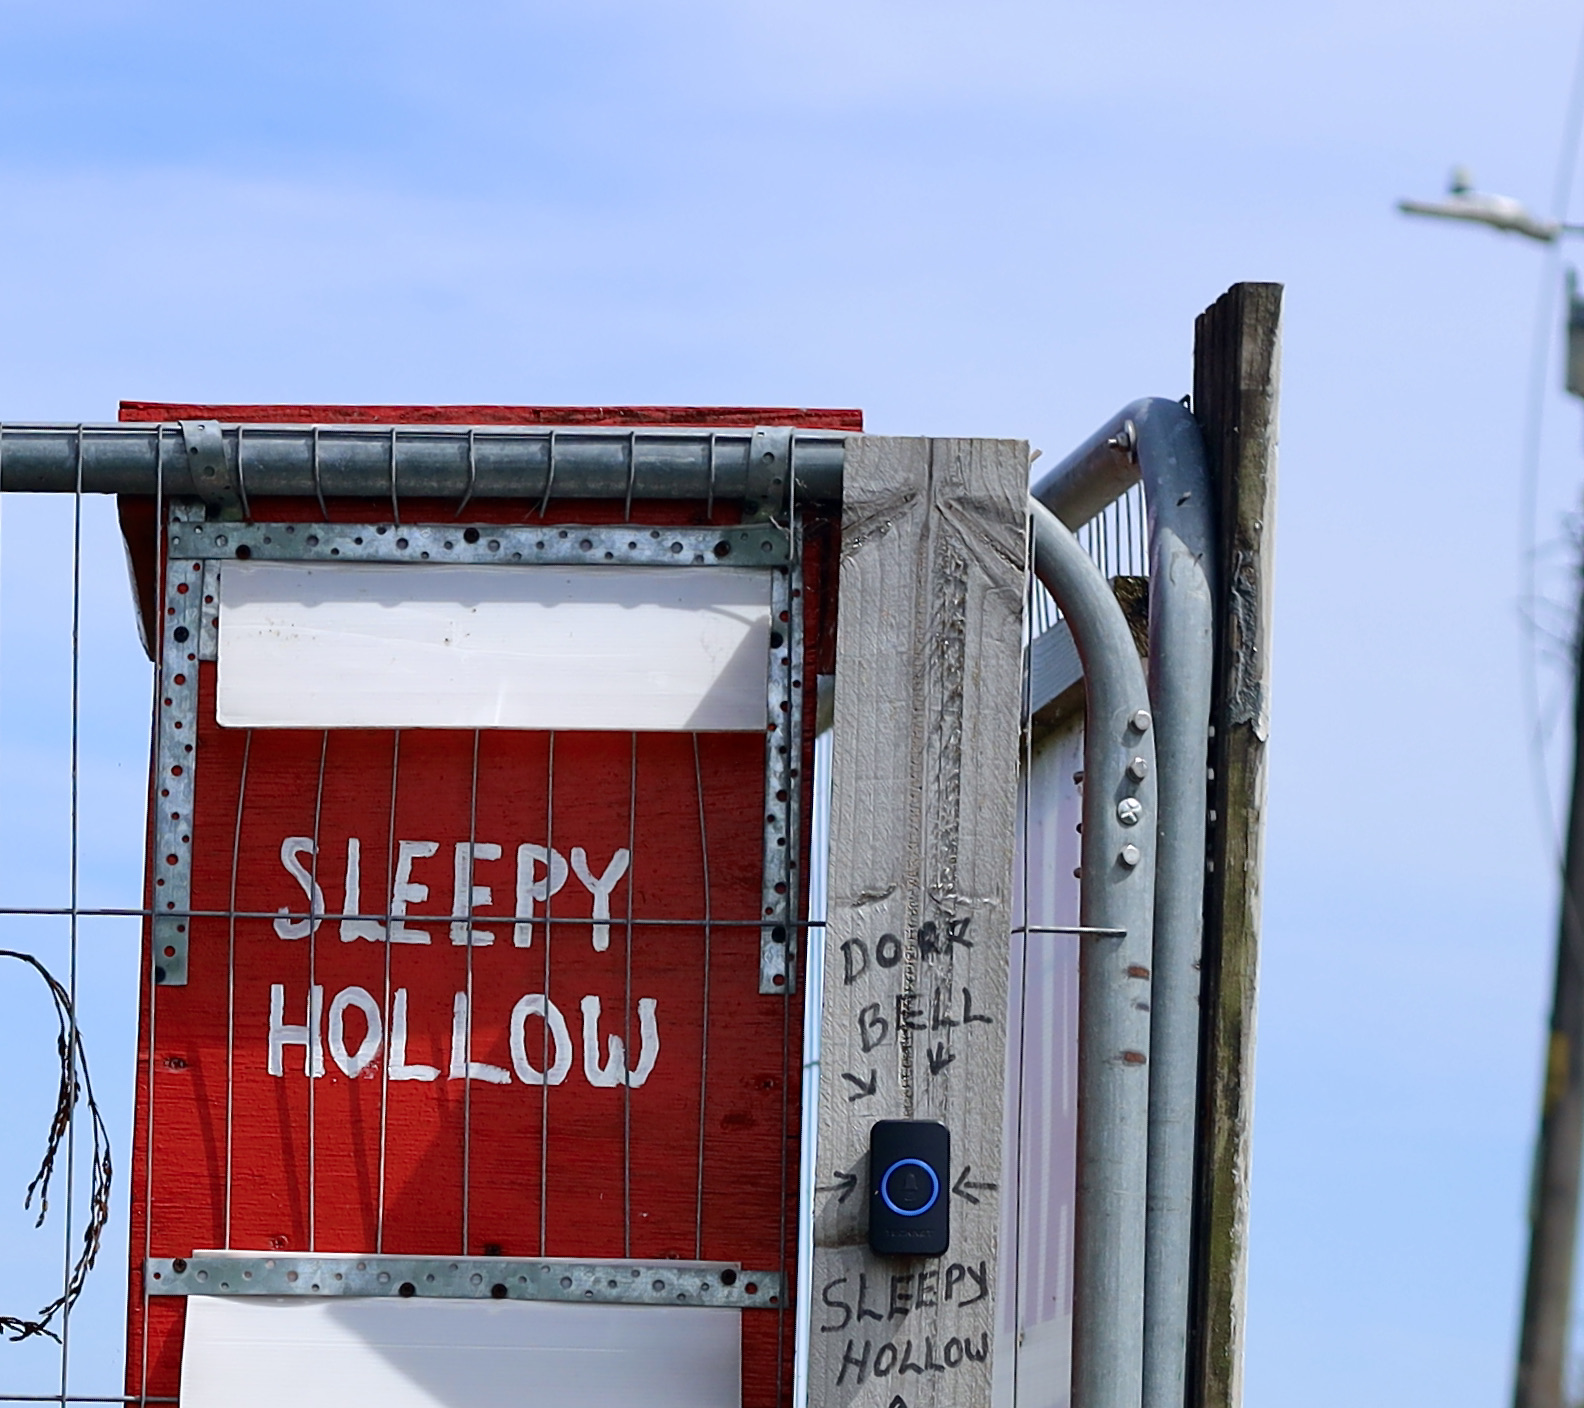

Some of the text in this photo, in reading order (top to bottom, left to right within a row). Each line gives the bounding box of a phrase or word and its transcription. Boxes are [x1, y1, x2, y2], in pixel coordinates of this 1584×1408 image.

[273, 837, 631, 953] SLEEPY
[268, 984, 660, 1090] HOLLOW
[858, 987, 993, 1053] BELL
[820, 1260, 989, 1332] SLEEPY
[835, 1331, 989, 1386] HOLLOW
